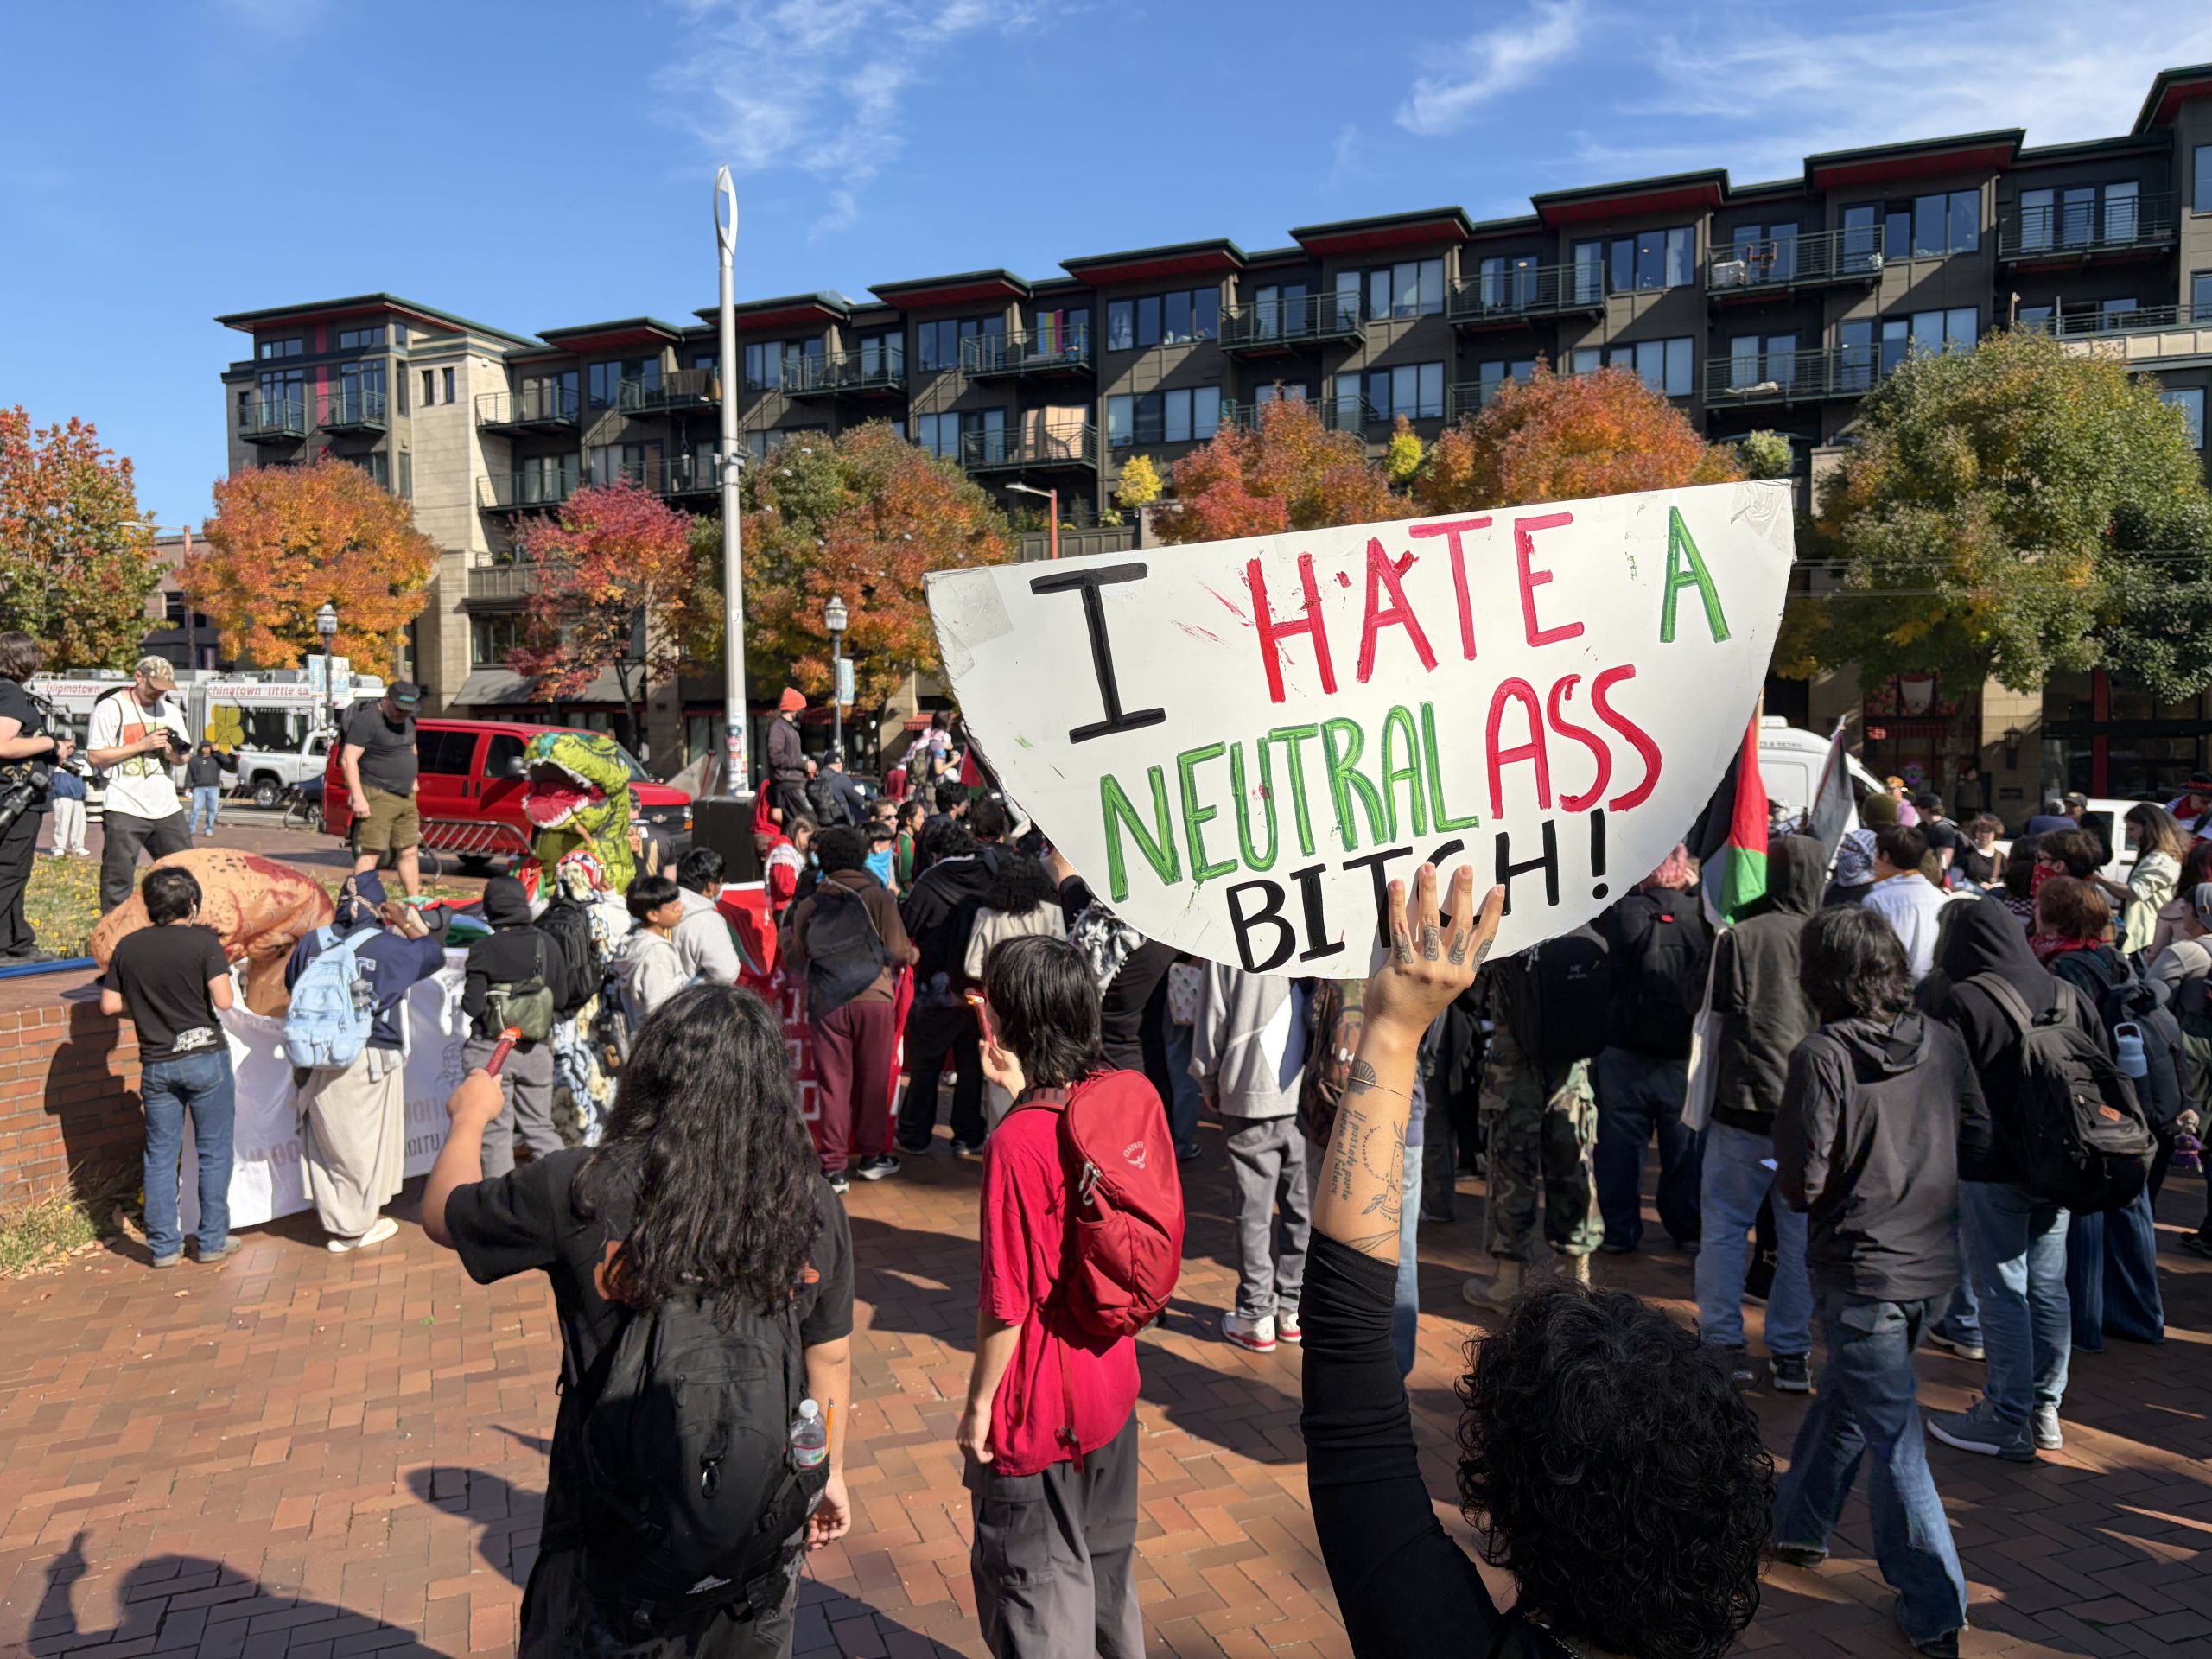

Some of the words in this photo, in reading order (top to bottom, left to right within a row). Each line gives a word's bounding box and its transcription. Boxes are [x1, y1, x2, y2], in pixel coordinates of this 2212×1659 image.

[1029, 562, 1166, 744] I
[1245, 511, 1585, 704] HATE
[1659, 505, 1731, 643] A
[45, 683, 101, 696] filipinotown
[207, 685, 262, 697] chinatown
[268, 685, 294, 697] little
[1100, 701, 1479, 903] NEUTRAL
[1486, 664, 1662, 820] ASS
